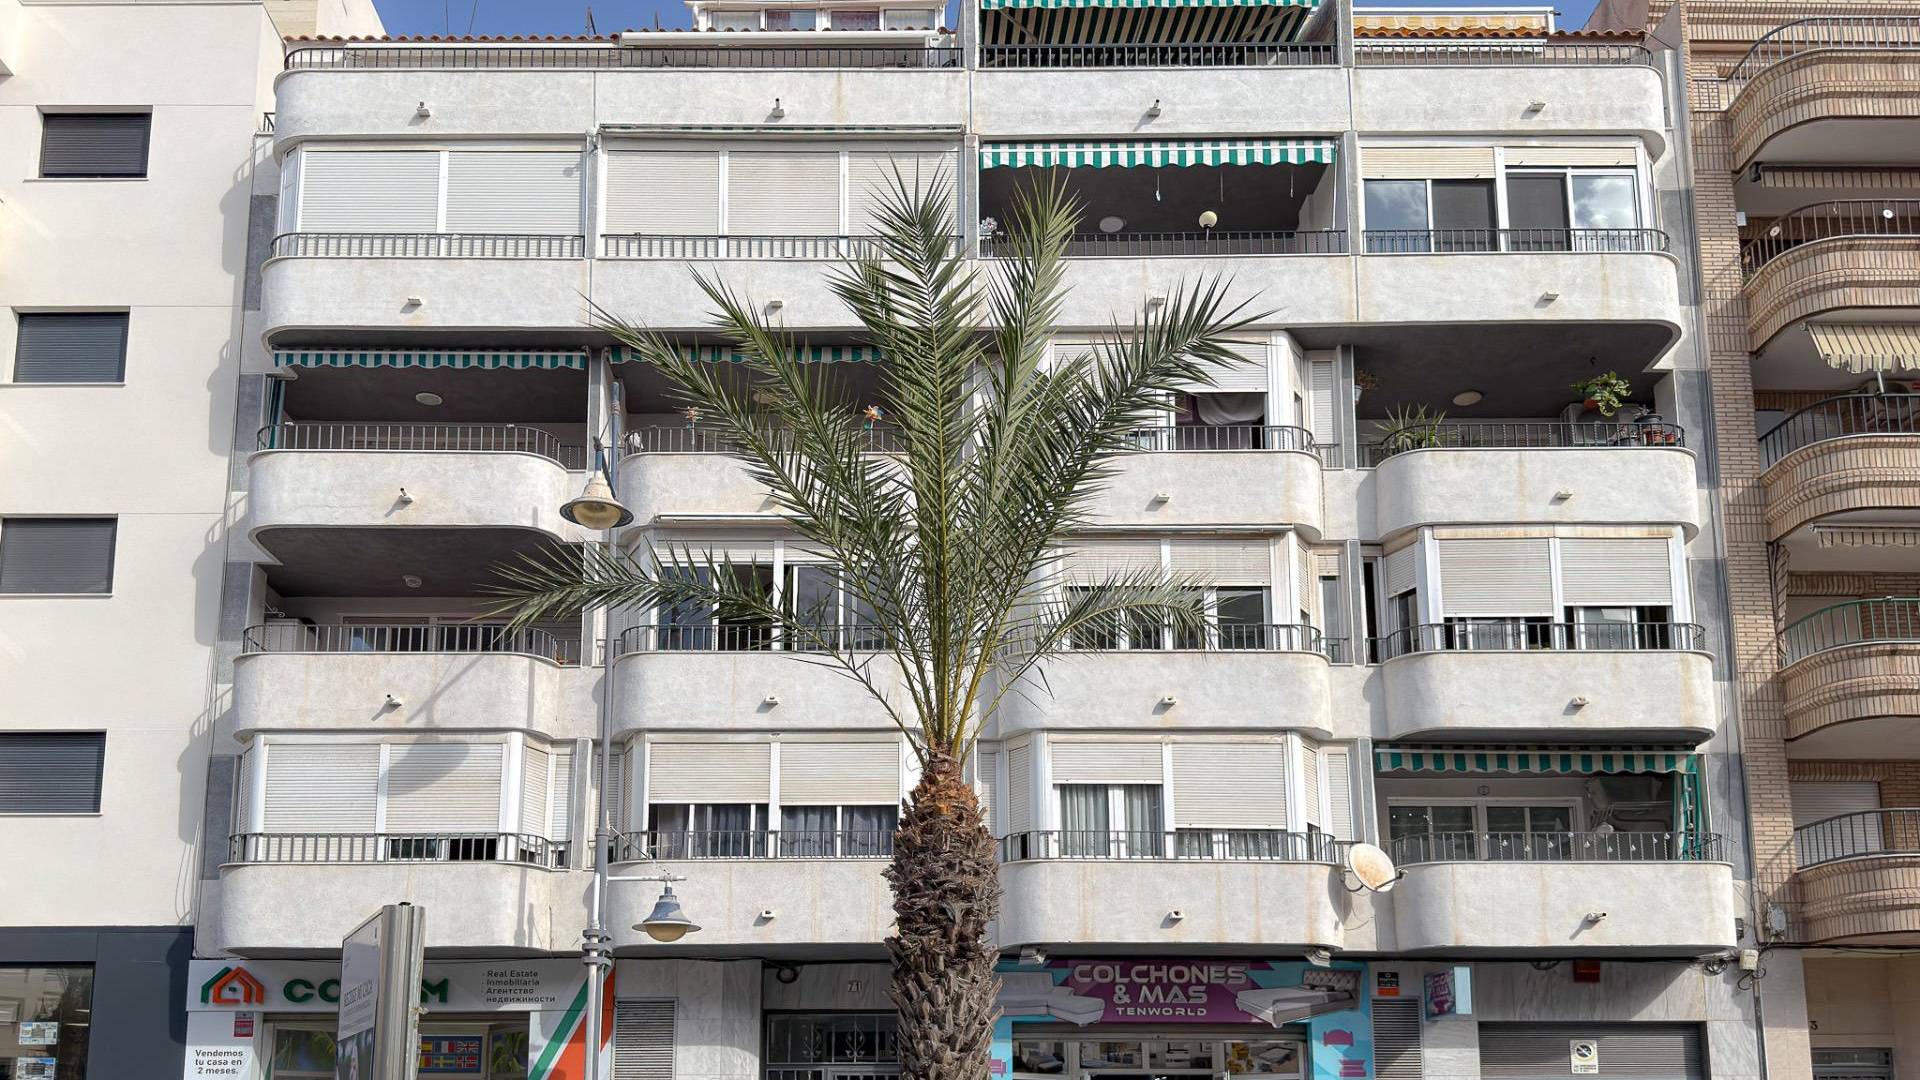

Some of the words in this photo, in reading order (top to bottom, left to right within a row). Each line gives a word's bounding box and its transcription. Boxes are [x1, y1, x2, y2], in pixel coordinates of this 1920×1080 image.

[1074, 965, 1247, 984] COLCHONES
[1113, 985, 1131, 1004] &
[1138, 985, 1208, 1004] MAS
[1116, 1007, 1207, 1016] TENWORLD
[195, 1049, 243, 1057] Vendemos
